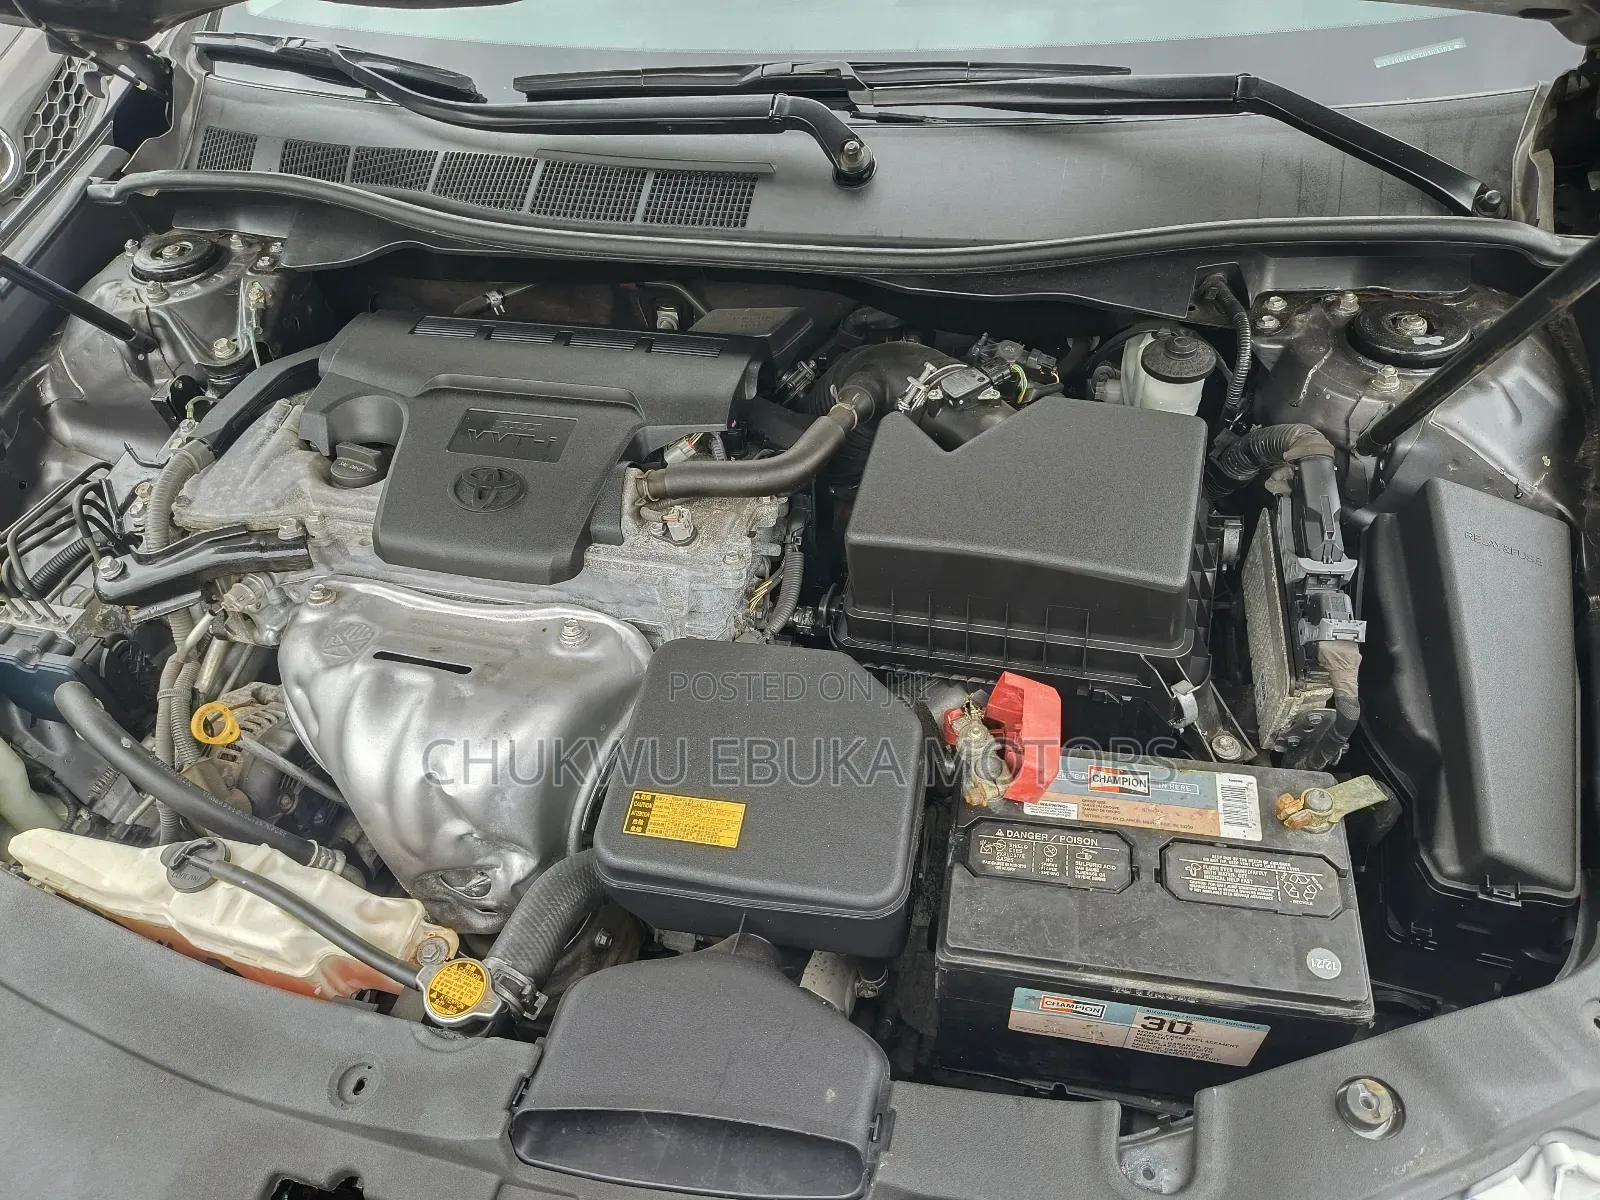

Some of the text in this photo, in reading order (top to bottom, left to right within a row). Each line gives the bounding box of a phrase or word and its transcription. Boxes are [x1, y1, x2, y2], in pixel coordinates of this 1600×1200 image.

[1092, 774, 1148, 790] CHAMPION
[1169, 783, 1193, 792] HERE
[1006, 829, 1048, 841] DANGER
[1059, 835, 1098, 847] POISON
[172, 871, 202, 882] COOLANT
[1311, 957, 1338, 971] 12/21
[458, 966, 482, 981] CAUTION
[439, 994, 465, 1010] ATTENTION
[1044, 999, 1102, 1015] CHAMPION
[1140, 1015, 1194, 1036] 30
[1186, 1037, 1240, 1049] REPLACEMENT
